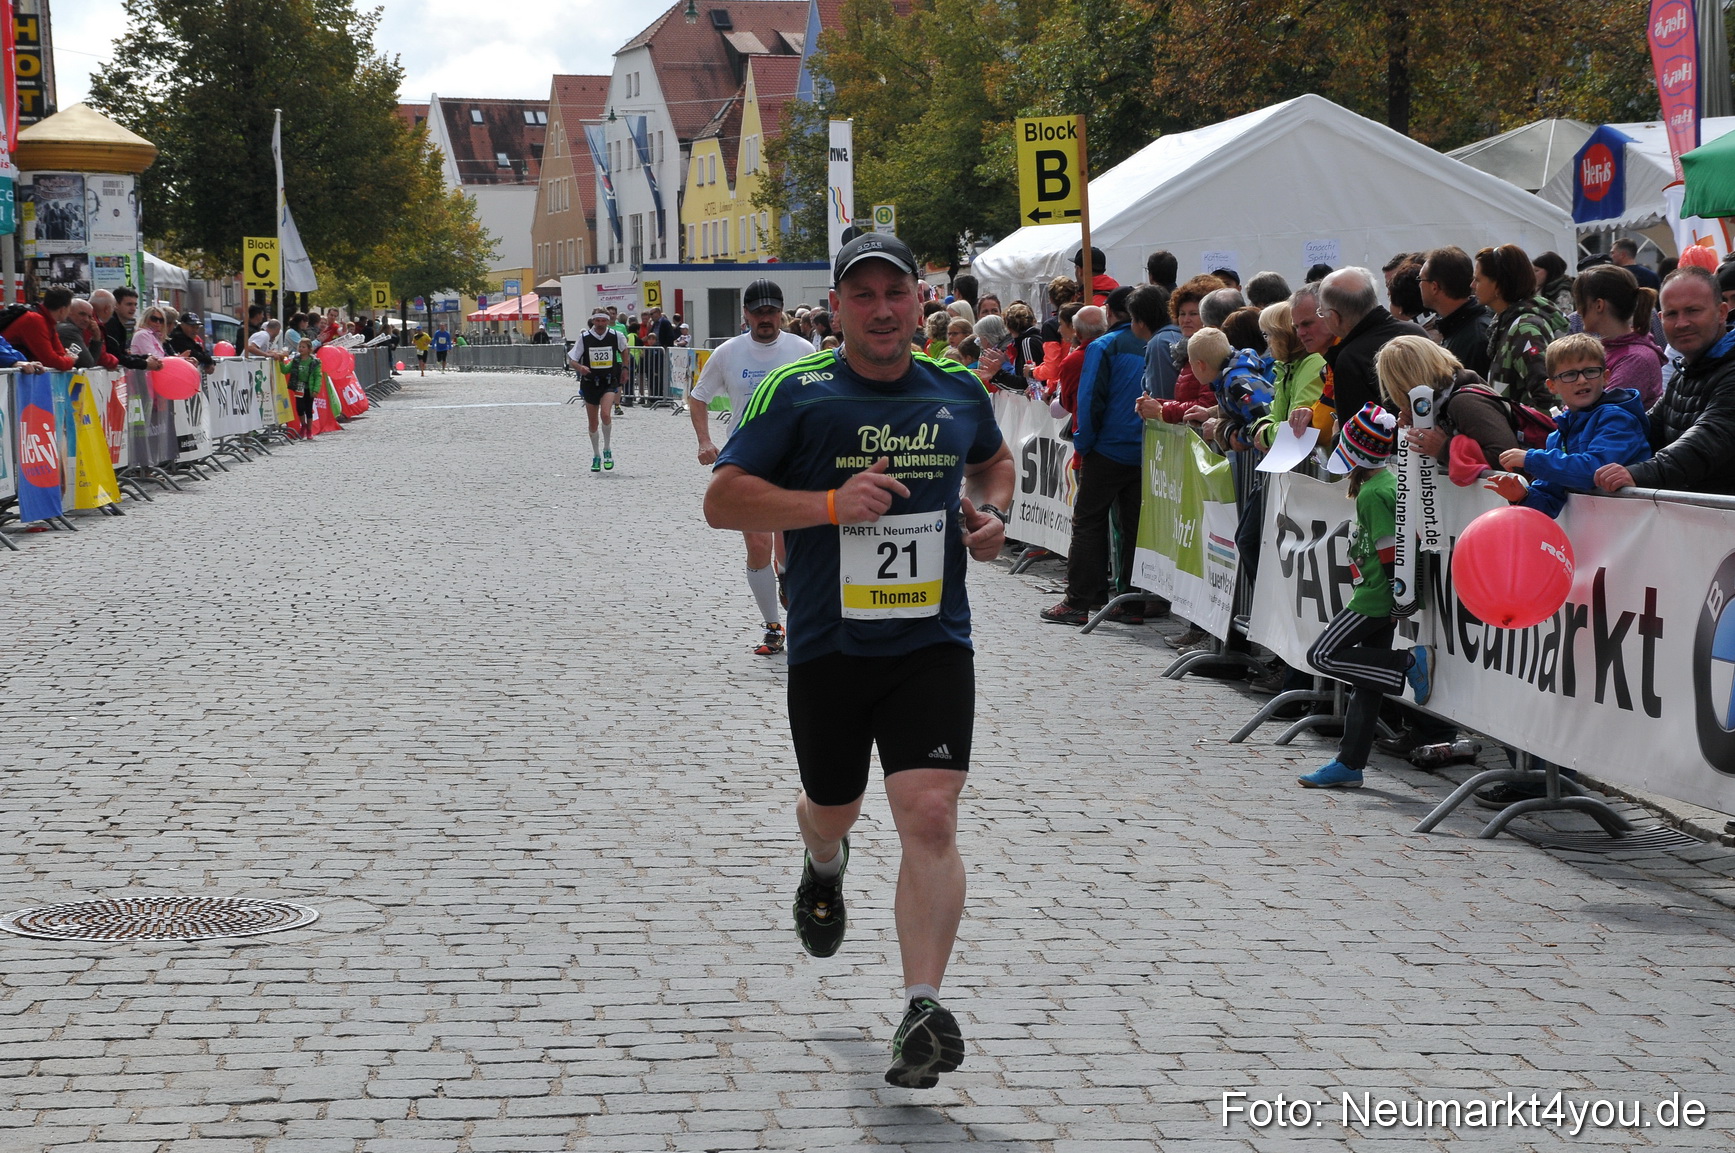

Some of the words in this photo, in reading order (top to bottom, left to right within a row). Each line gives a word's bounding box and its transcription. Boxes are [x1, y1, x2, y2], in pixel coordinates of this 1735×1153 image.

[1024, 120, 1078, 142] Block
[1036, 150, 1071, 202] B
[1582, 156, 1612, 188] Hervis
[247, 239, 275, 250] Block
[252, 252, 271, 279] C
[376, 290, 386, 304] D
[648, 289, 657, 302] D
[593, 352, 609, 361] 323
[796, 371, 834, 386] zillo
[20, 421, 58, 470] Hervi
[857, 422, 939, 453] Blond!
[835, 456, 873, 469] MADE
[1394, 439, 1411, 567] bmw-laufsport.de
[843, 525, 880, 537] PARTL
[883, 524, 932, 536] Neumarkt
[876, 540, 917, 579] 21
[1540, 541, 1574, 577] RÖD
[870, 590, 927, 605] Thomas
[928, 752, 952, 760] adidas
